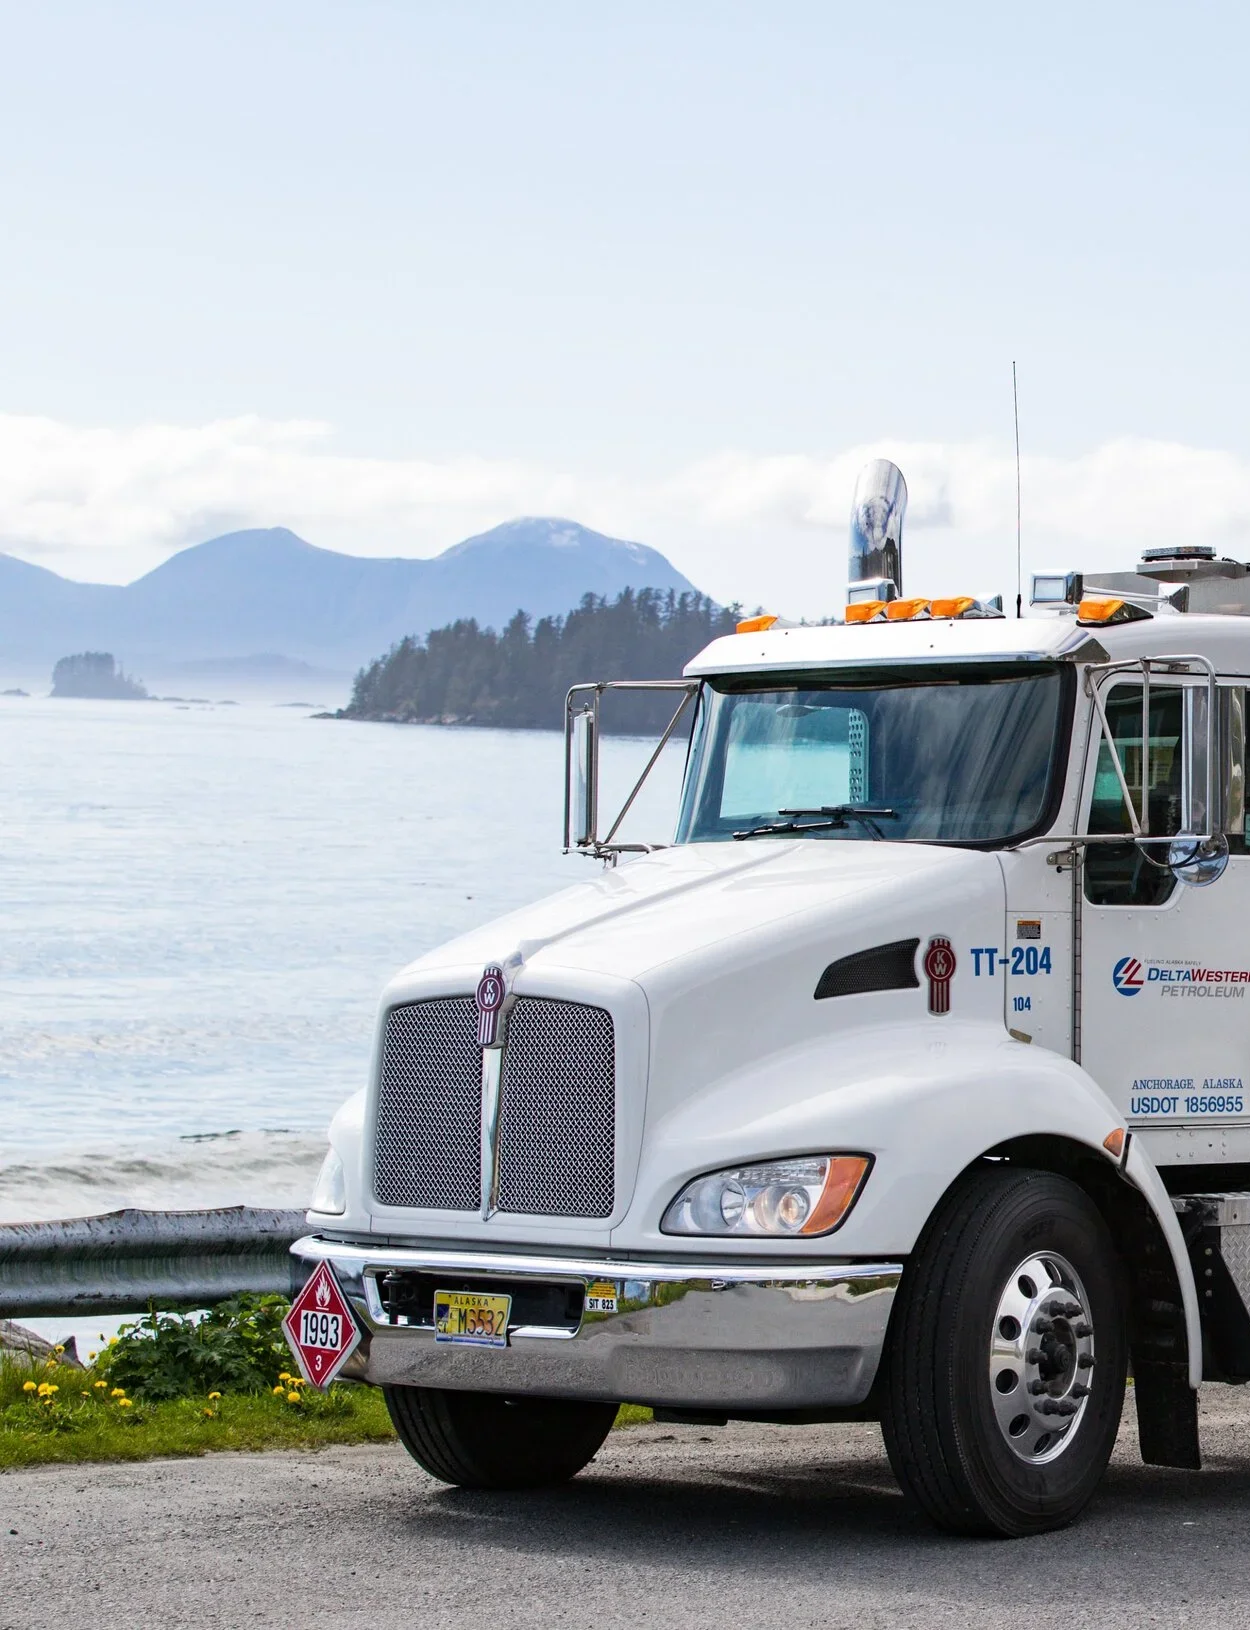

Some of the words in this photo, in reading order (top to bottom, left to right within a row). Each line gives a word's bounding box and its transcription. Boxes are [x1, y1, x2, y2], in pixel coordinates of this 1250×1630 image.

[970, 946, 1052, 976] TT-204
[1160, 985, 1245, 998] PETROLEUM
[1013, 997, 1031, 1011] 104
[1132, 1080, 1195, 1090] ANCHORAGE,
[1202, 1079, 1243, 1089] ALASKA
[1131, 1097, 1179, 1113] USDOT
[1184, 1096, 1243, 1113] 1856955
[454, 1296, 488, 1306] ALASKA
[589, 1298, 599, 1309] SIT
[602, 1299, 613, 1310] 823
[303, 1313, 339, 1348] 1993
[315, 1355, 322, 1371] 3
